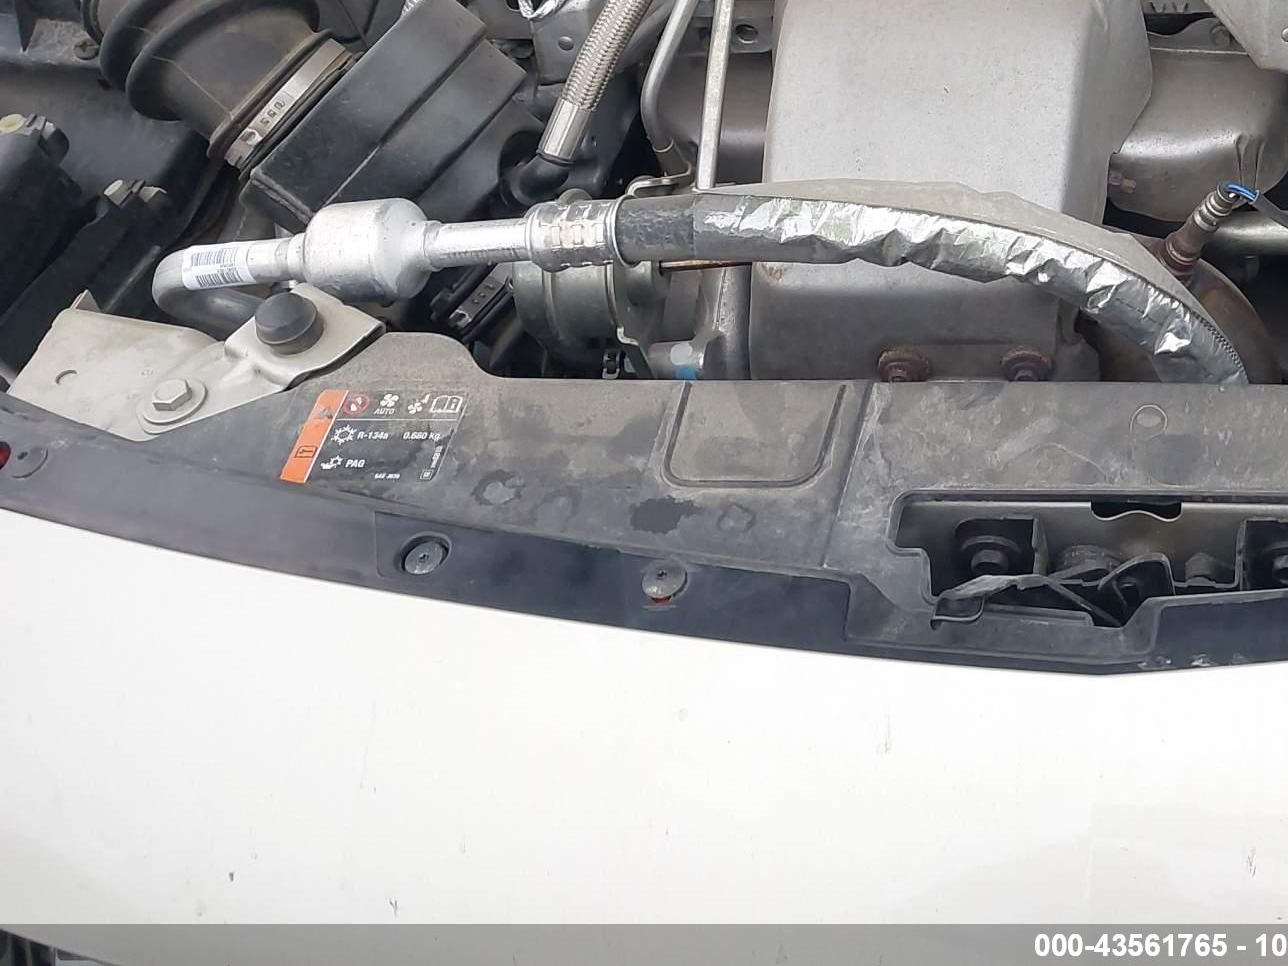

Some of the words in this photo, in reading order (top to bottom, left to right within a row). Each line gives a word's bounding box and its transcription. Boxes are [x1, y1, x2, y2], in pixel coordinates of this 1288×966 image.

[374, 407, 395, 415] AUTO
[356, 431, 389, 440] R-134a
[345, 459, 366, 468] PAG
